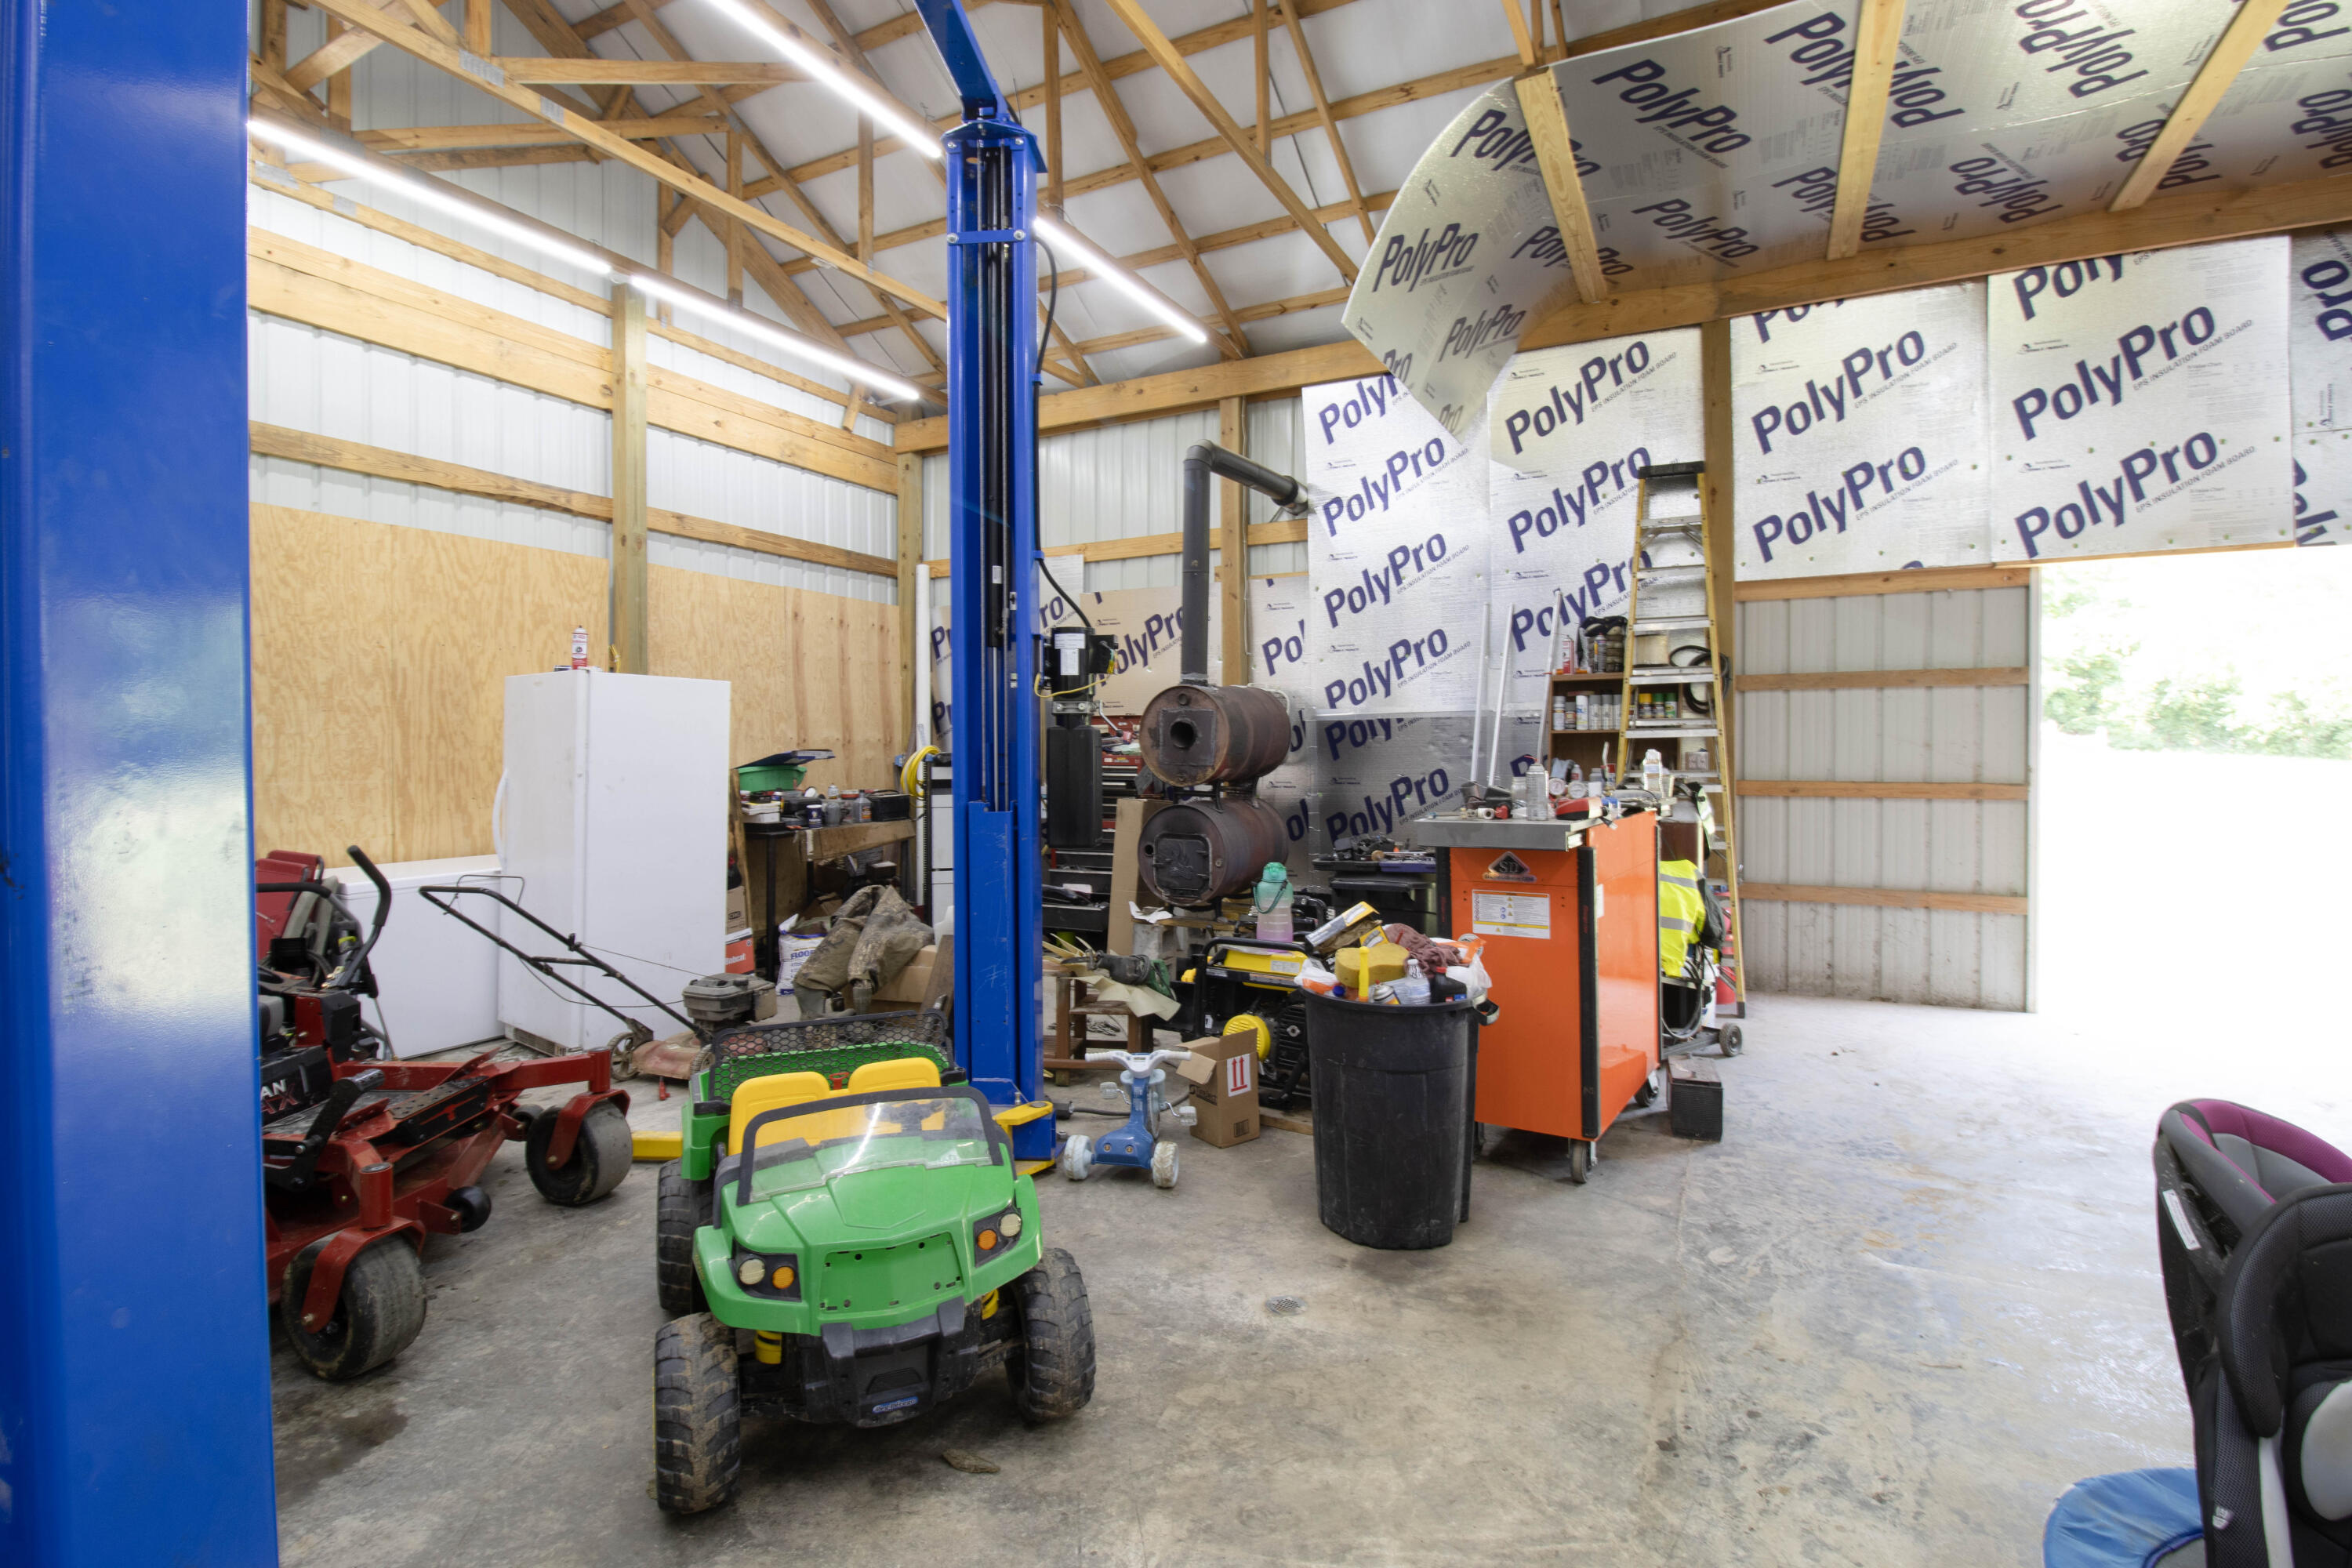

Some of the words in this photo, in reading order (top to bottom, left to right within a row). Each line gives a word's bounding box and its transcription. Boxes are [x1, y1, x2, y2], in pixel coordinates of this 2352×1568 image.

[1591, 59, 1751, 154] PolyPro
[1631, 198, 1759, 259] PolyPro
[1949, 158, 2063, 223] PolyPro
[1372, 223, 1479, 292] PolyPro
[1437, 304, 1526, 362] PolyPro
[2012, 307, 2215, 441] PolyPro
[2132, 377, 2149, 391] EPS
[2150, 350, 2198, 383] INSULATION
[2198, 336, 2224, 354] FOAM
[2225, 319, 2252, 339] BOARD
[1505, 341, 1650, 455] PolyPro
[1604, 378, 1638, 405] INSULATION
[1751, 330, 1925, 456] PolyPro
[1323, 437, 1445, 537] PolyPro
[1508, 447, 1651, 554] PolyPro
[1752, 446, 1926, 563] PolyPro
[2014, 431, 2217, 559] PolyPro
[2136, 499, 2151, 514] EPS
[2152, 474, 2200, 506] INSULATION
[2227, 445, 2255, 465] BOARD
[1323, 533, 1446, 629] PolyPro
[1324, 629, 1448, 709] PolyPro
[1325, 768, 1449, 844] PolyPro
